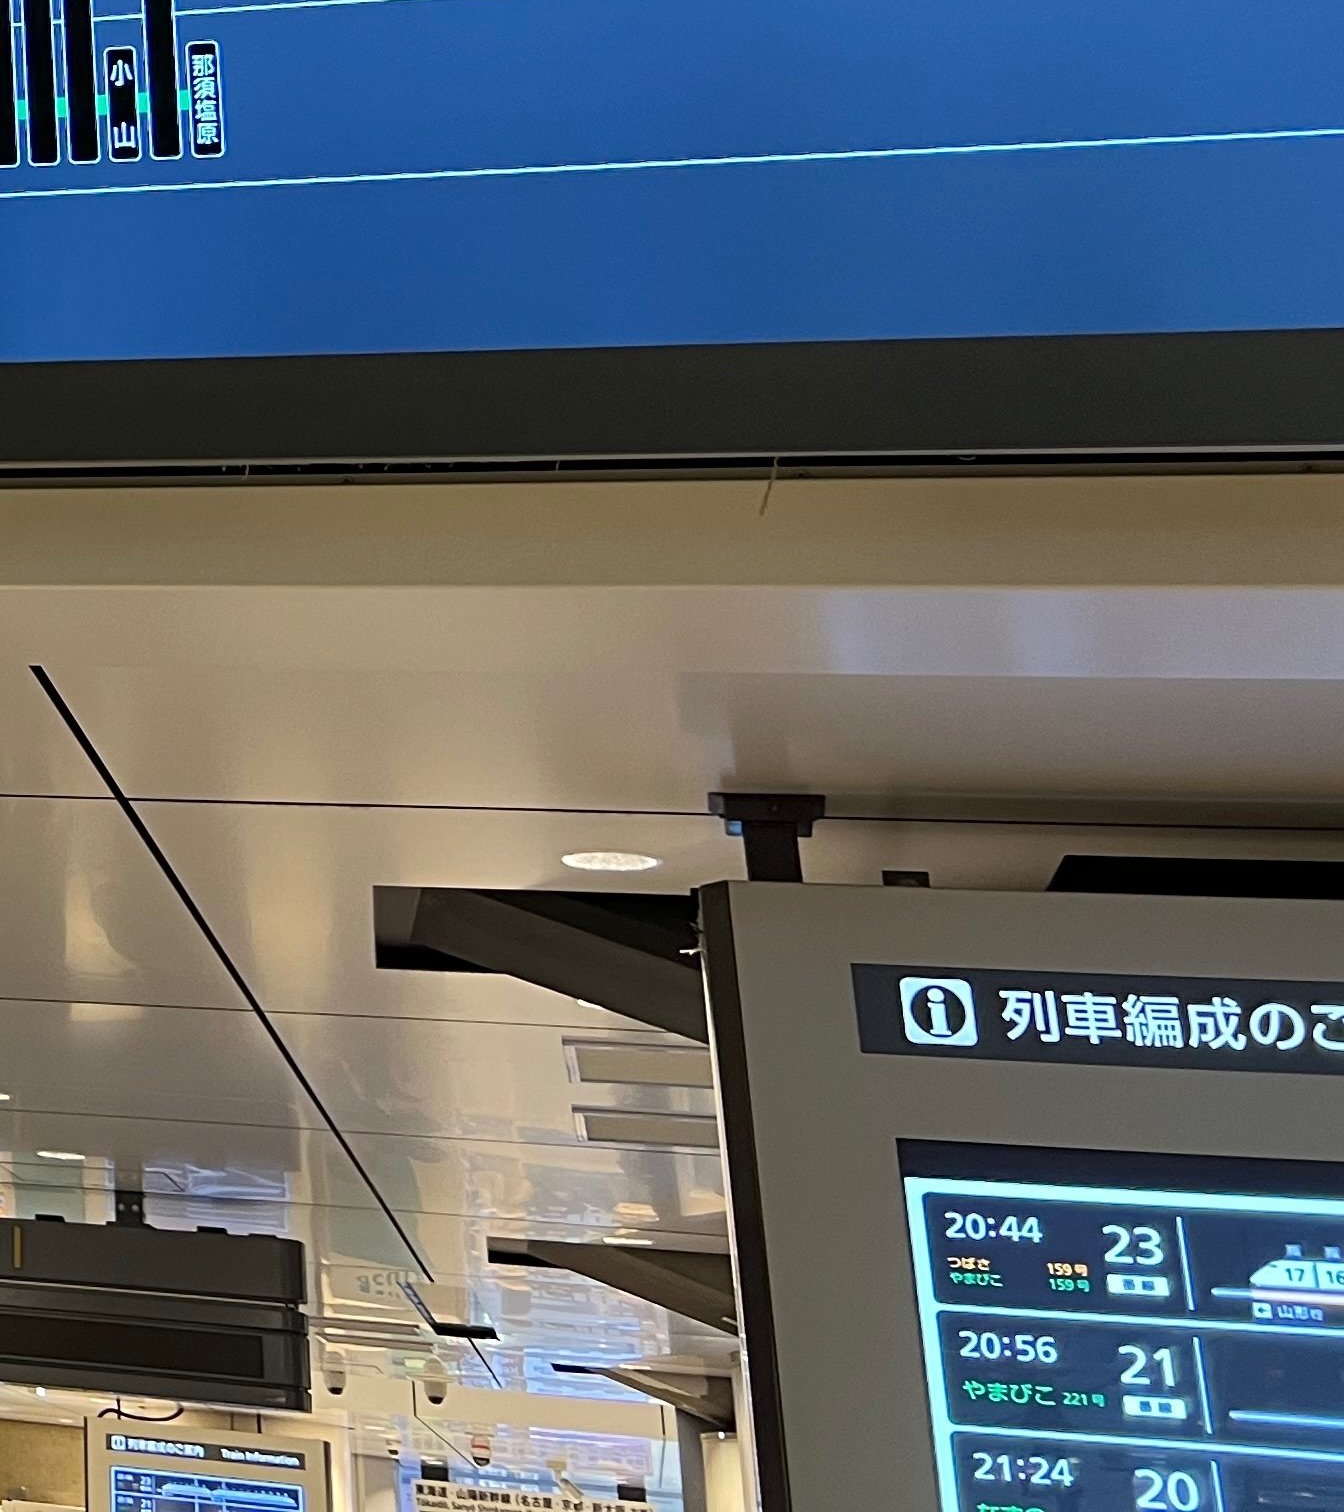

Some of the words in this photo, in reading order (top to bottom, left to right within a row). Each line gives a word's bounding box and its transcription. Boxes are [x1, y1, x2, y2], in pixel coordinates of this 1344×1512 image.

[109, 58, 137, 150] 小山
[191, 53, 219, 146] 那須塩原
[944, 1210, 1044, 1244] 20:44
[1101, 1224, 1165, 1267] 23
[946, 1255, 991, 1272] つばさ
[949, 1271, 1004, 1288] やまびこ
[1285, 1267, 1305, 1282] 17
[957, 1329, 1059, 1364] 20:56
[1117, 1344, 1177, 1388] 21
[962, 1379, 1057, 1406] やまびこ
[971, 1451, 1074, 1487] 21:24
[1134, 1468, 1199, 1512] 20
